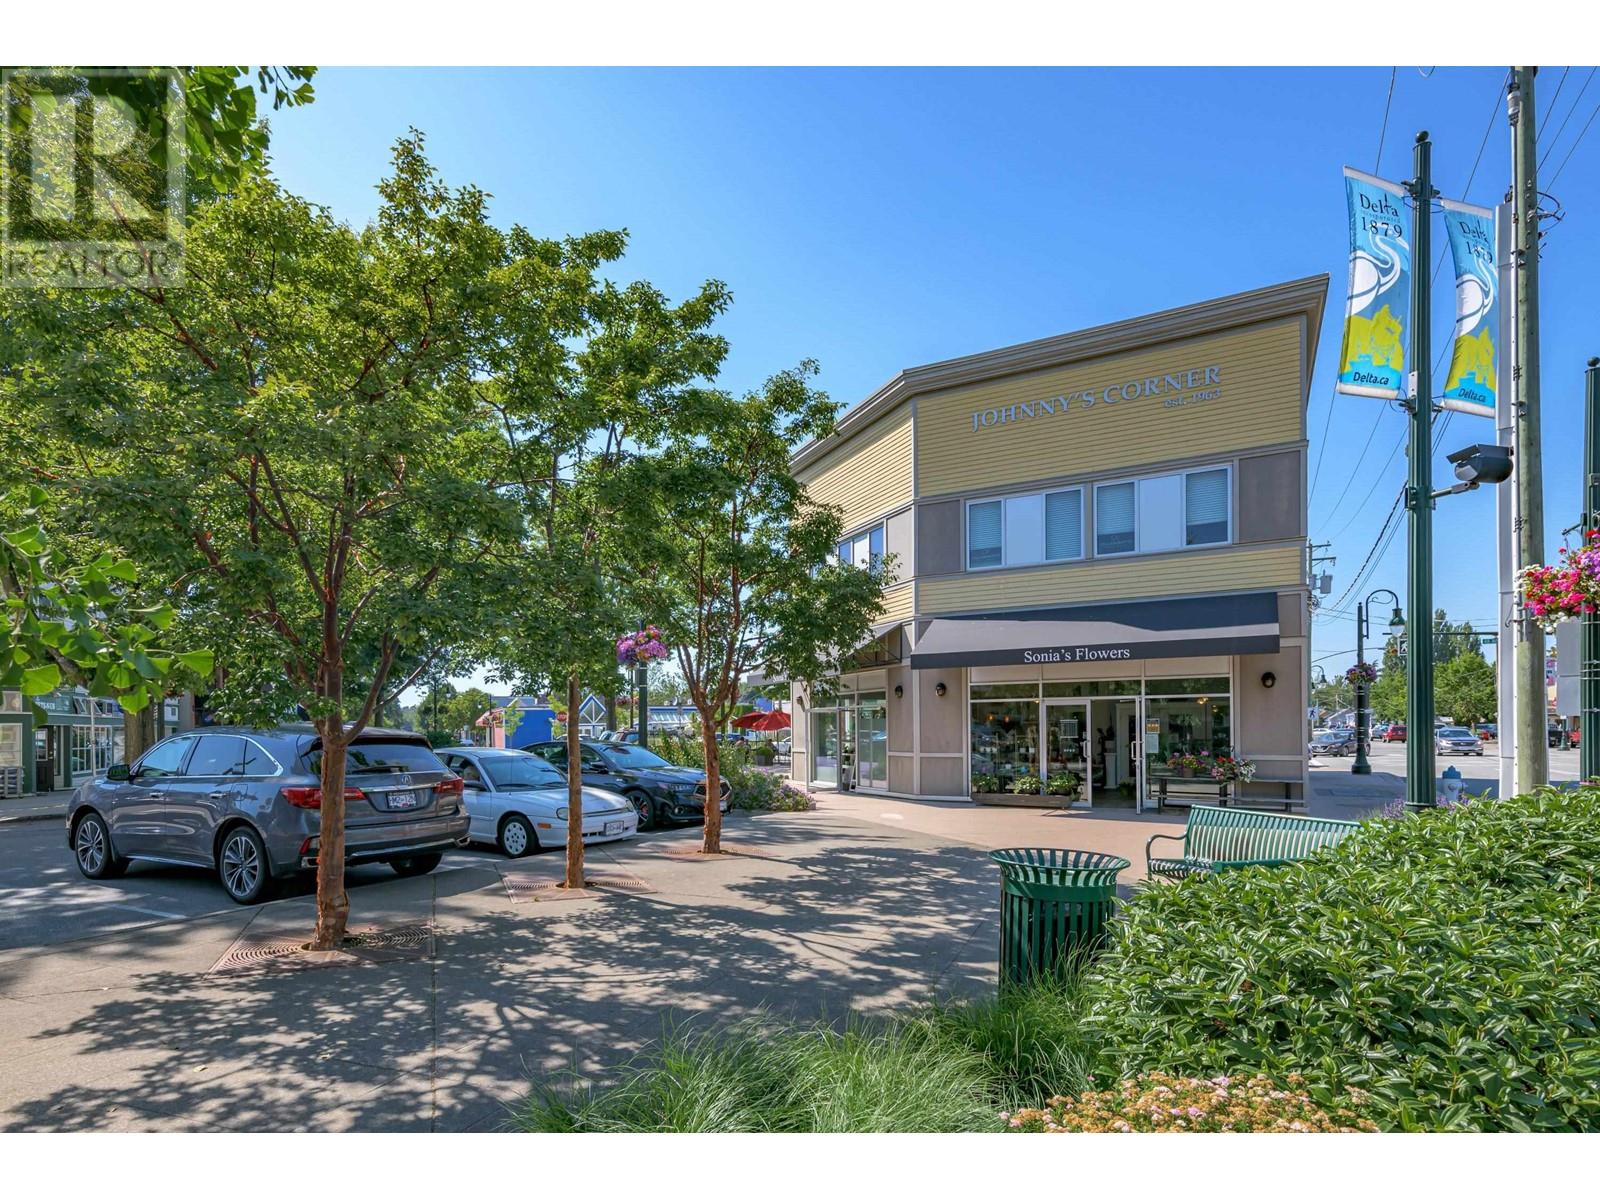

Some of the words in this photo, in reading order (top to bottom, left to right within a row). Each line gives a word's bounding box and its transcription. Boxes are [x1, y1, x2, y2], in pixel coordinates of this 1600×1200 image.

[1359, 192, 1399, 217] Delta
[1361, 216, 1403, 238] 1879
[1353, 371, 1390, 386] Delta.ca
[971, 388, 1096, 432] JOHNNY'S
[1102, 365, 1222, 404] CORNER
[1164, 394, 1187, 408] est.
[1457, 387, 1487, 403] Delta.ca
[1024, 649, 1072, 663] Sonia's
[1075, 647, 1131, 661] Flowers
